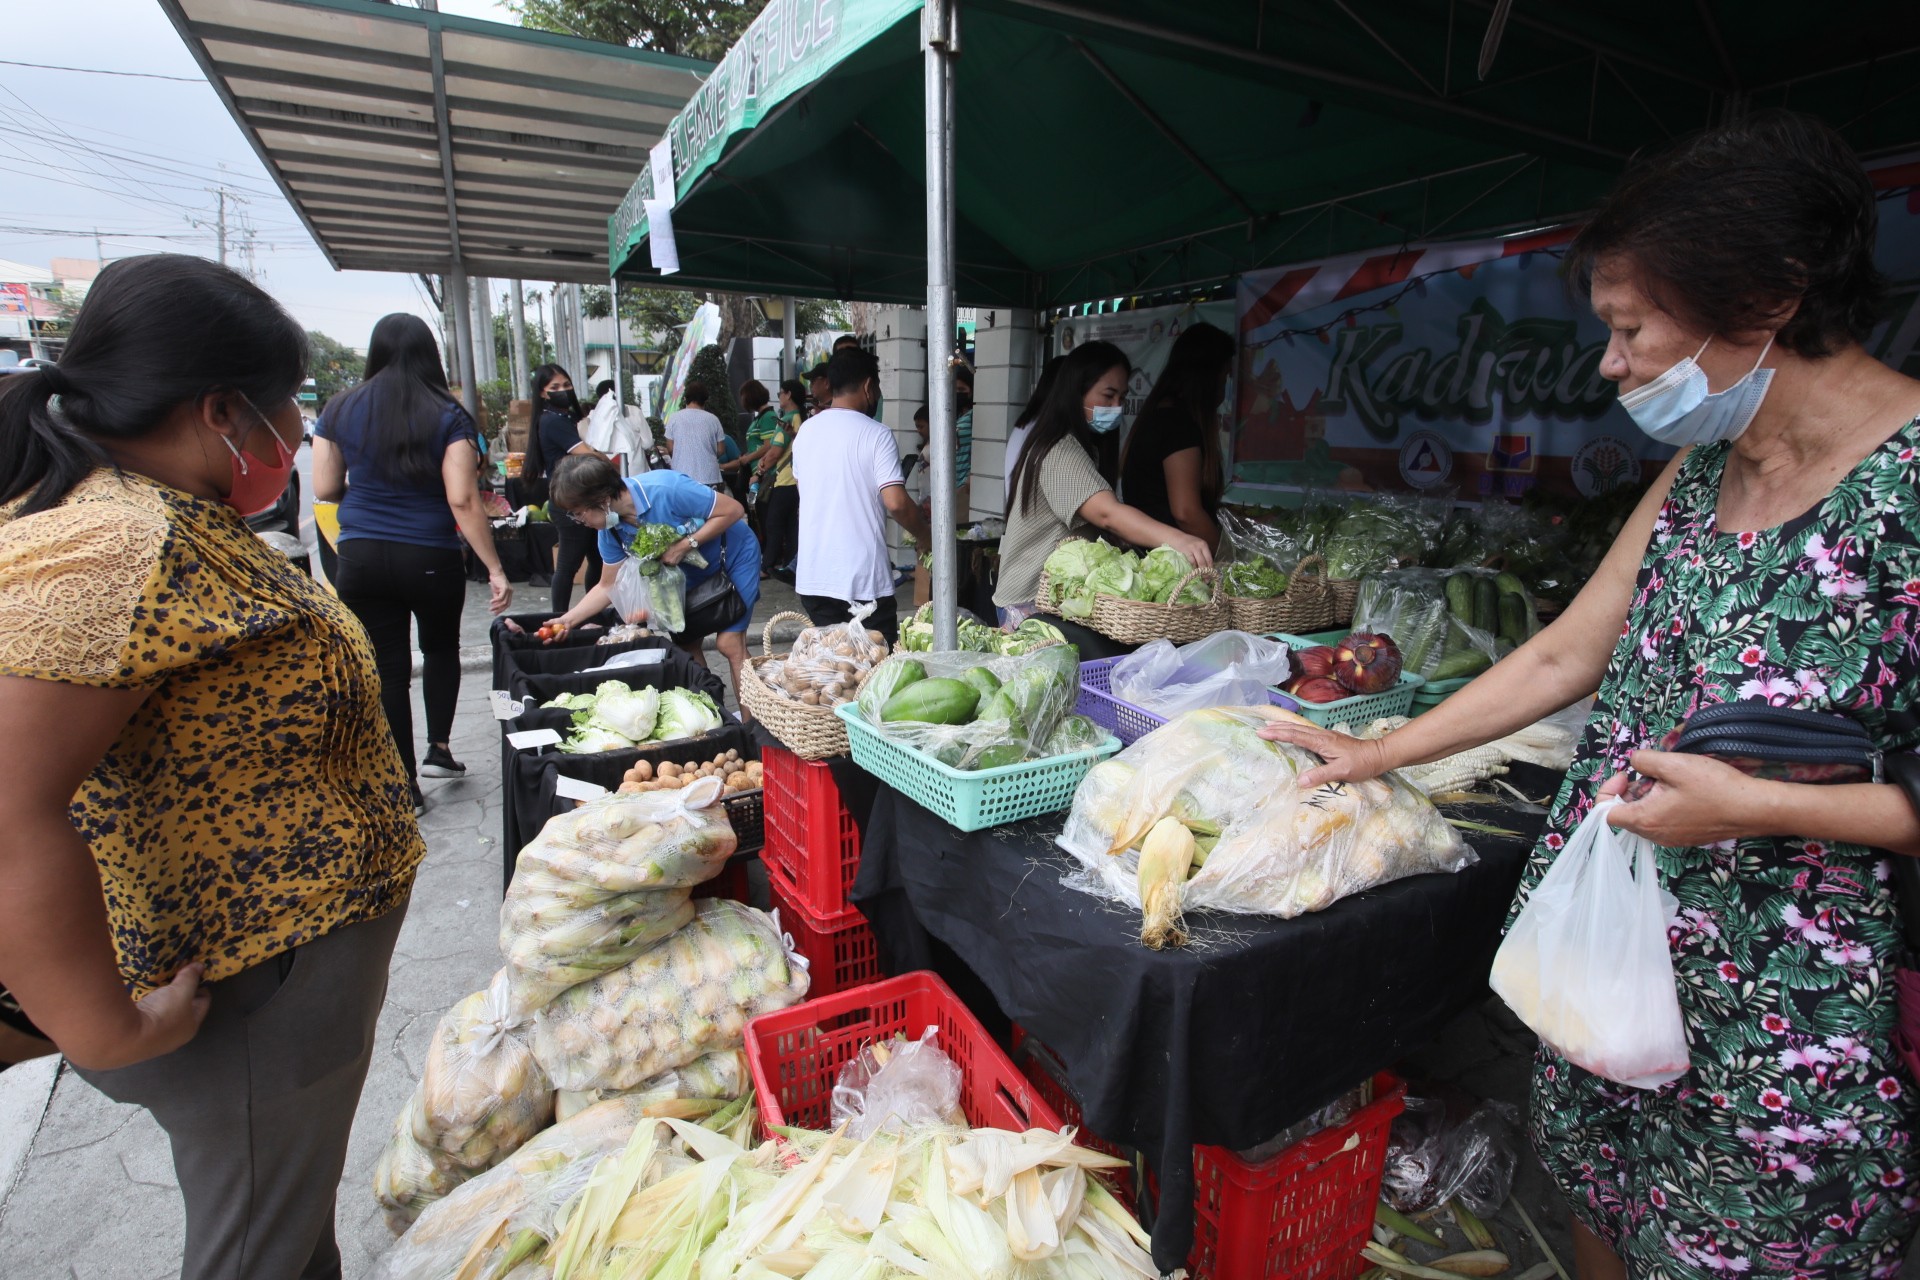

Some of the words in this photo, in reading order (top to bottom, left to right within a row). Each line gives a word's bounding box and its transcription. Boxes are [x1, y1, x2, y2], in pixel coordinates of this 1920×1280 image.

[671, 59, 727, 182] ELFARE
[728, 0, 835, 110] OFFICE
[1320, 312, 1614, 430] Kadiwa
[1573, 437, 1600, 472] DEPARTMENT
